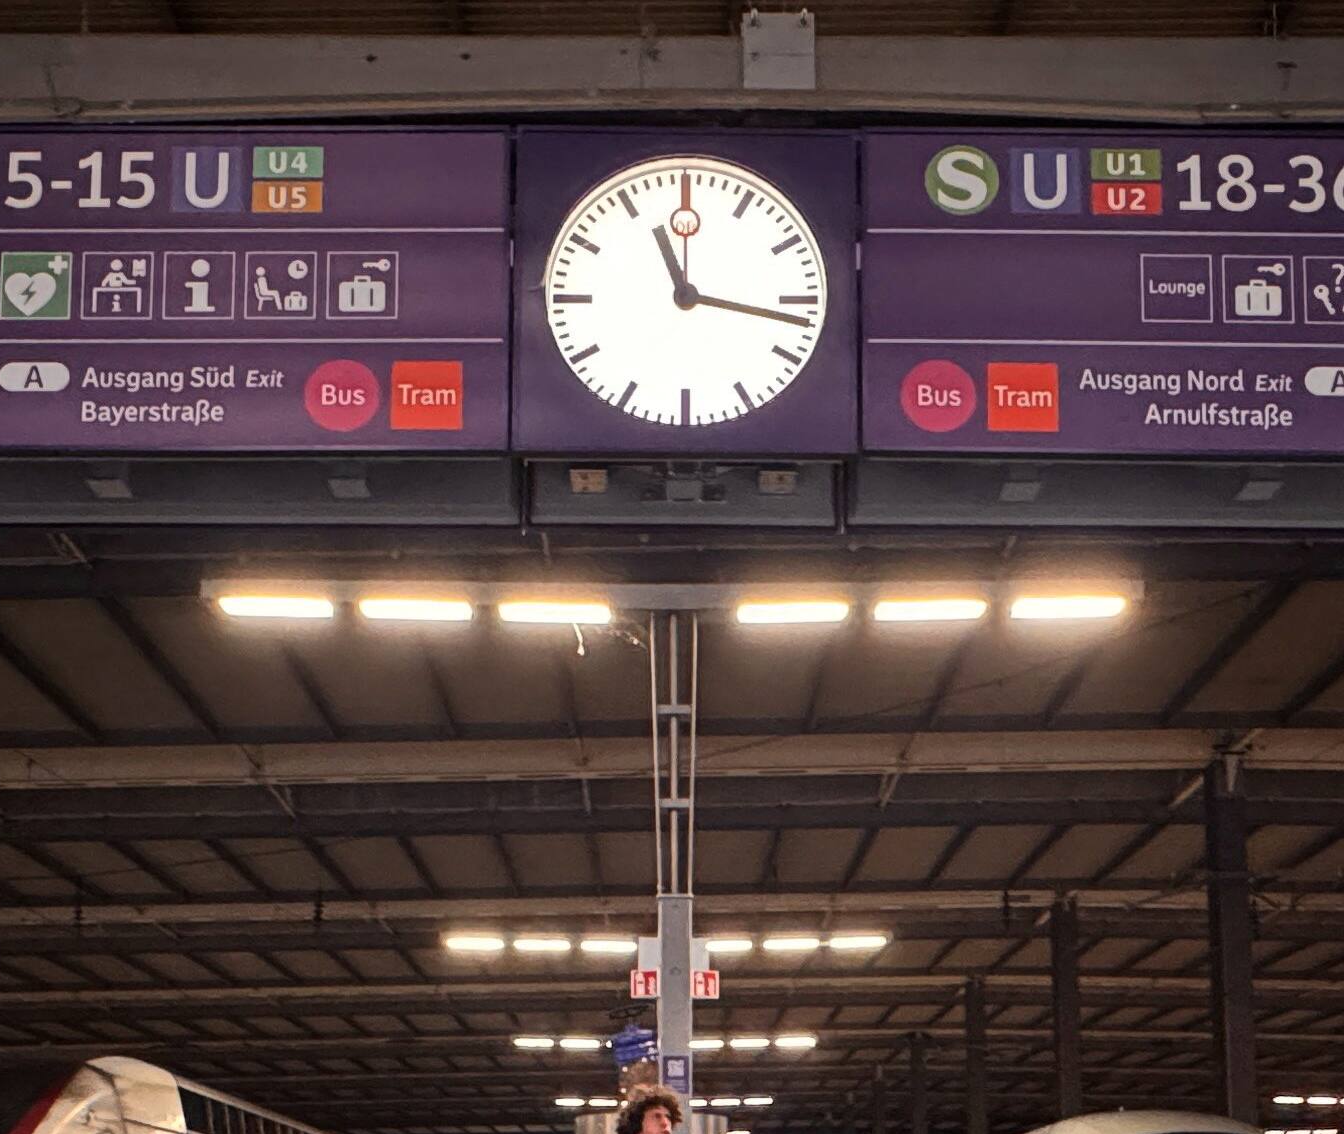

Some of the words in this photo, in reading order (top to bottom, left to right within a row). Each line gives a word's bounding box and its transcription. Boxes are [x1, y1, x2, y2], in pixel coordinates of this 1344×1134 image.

[268, 152, 308, 174] U4
[1106, 153, 1146, 175] U1
[4, 151, 156, 209] 5-15
[184, 151, 230, 209] U
[936, 152, 987, 210] S
[1022, 153, 1067, 210] U
[268, 187, 308, 209] U5
[1106, 188, 1146, 211] U2
[1149, 280, 1205, 298] Lounge
[23, 365, 44, 389] A
[82, 366, 184, 392] Ausgang
[190, 365, 235, 388] Süd
[246, 369, 284, 388] Exit
[1079, 369, 1181, 395] Ausgang
[1188, 370, 1244, 391] Nord
[1256, 373, 1292, 392] Exit
[320, 384, 365, 406] Bus
[398, 384, 457, 405] Tram
[917, 386, 961, 407] Bus
[994, 386, 1052, 407] Tram
[81, 400, 224, 426] Bayerstraße
[1145, 403, 1293, 429] Arnulfstraße
